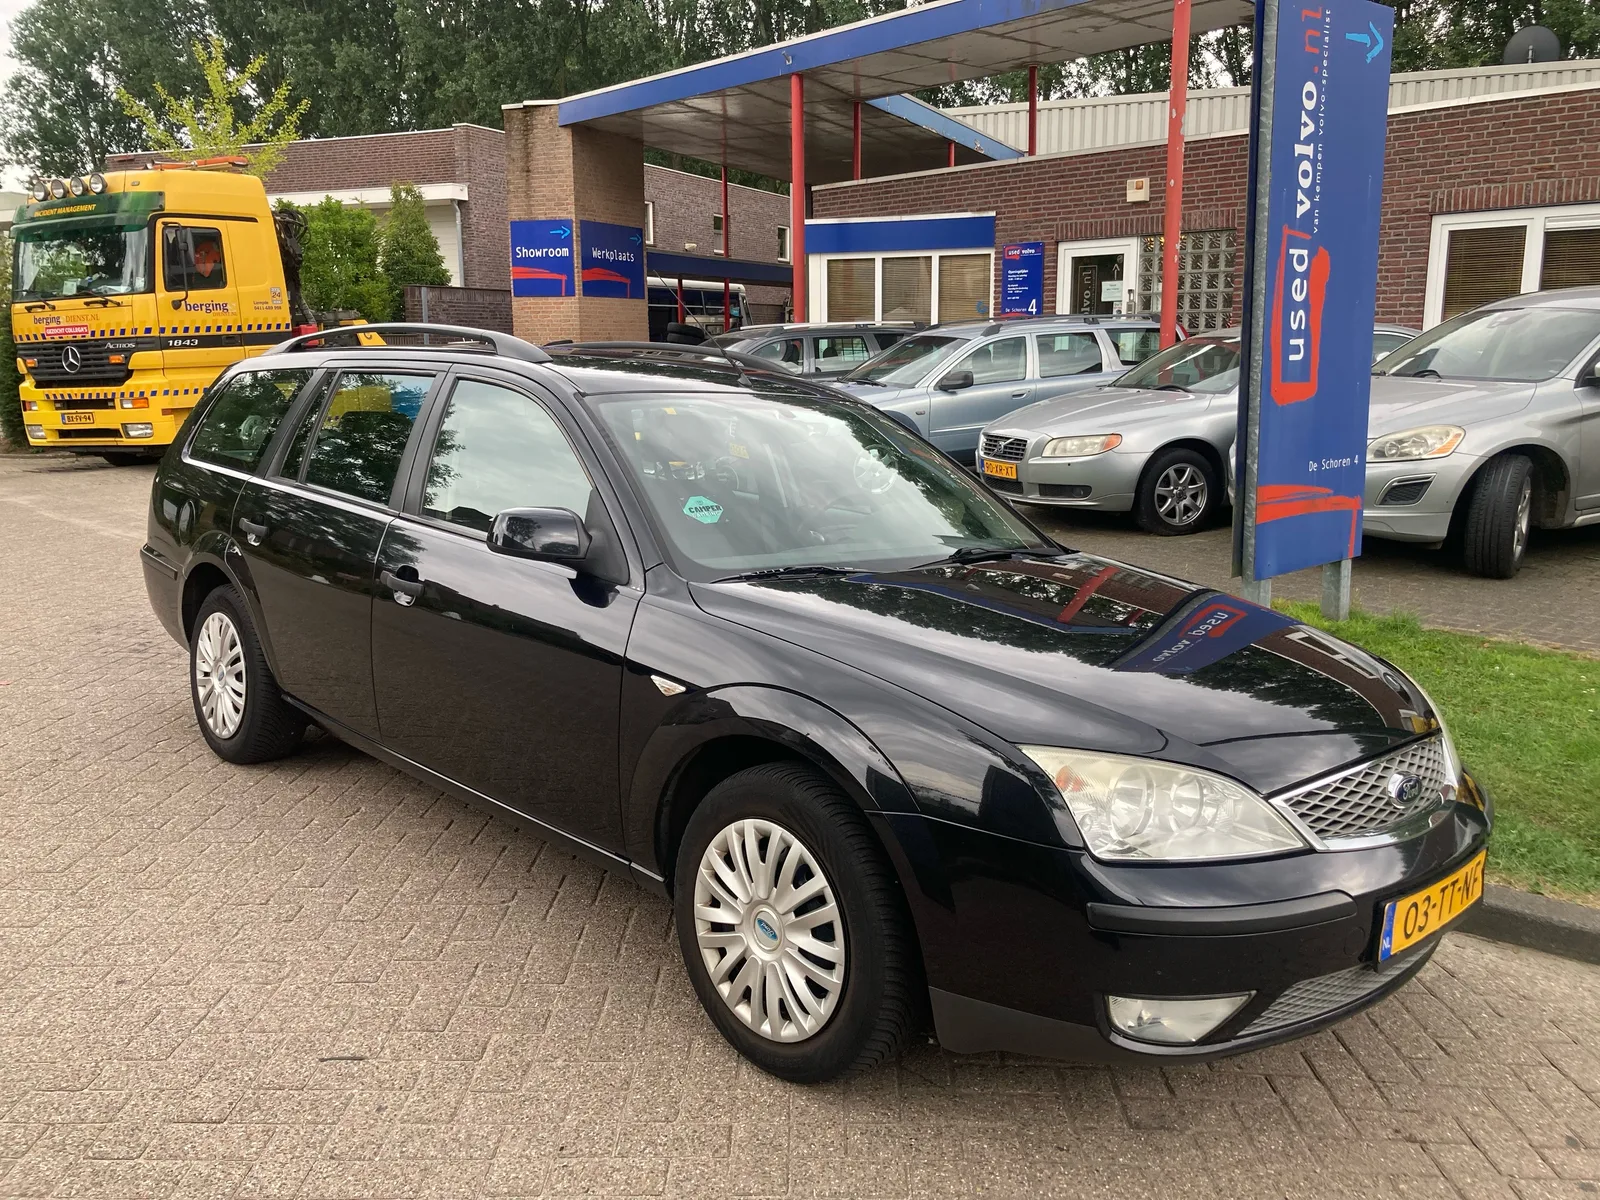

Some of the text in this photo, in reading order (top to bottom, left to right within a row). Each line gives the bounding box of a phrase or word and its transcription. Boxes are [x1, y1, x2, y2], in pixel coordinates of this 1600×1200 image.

[1318, 9, 1331, 136] volvo-specialist
[1314, 143, 1323, 202] kempen
[34, 204, 97, 217] INCIDENT MANAGEMENT
[515, 246, 569, 258] Showroom
[591, 247, 635, 262] Werkplaats
[185, 300, 229, 313] berging
[1028, 298, 1037, 315] 4
[1289, 249, 1309, 361] used
[33, 315, 61, 326] berging
[167, 339, 199, 347] 1843
[1308, 454, 1359, 472] De Schoren 4
[1382, 860, 1482, 951] NL 03-TT-NF
